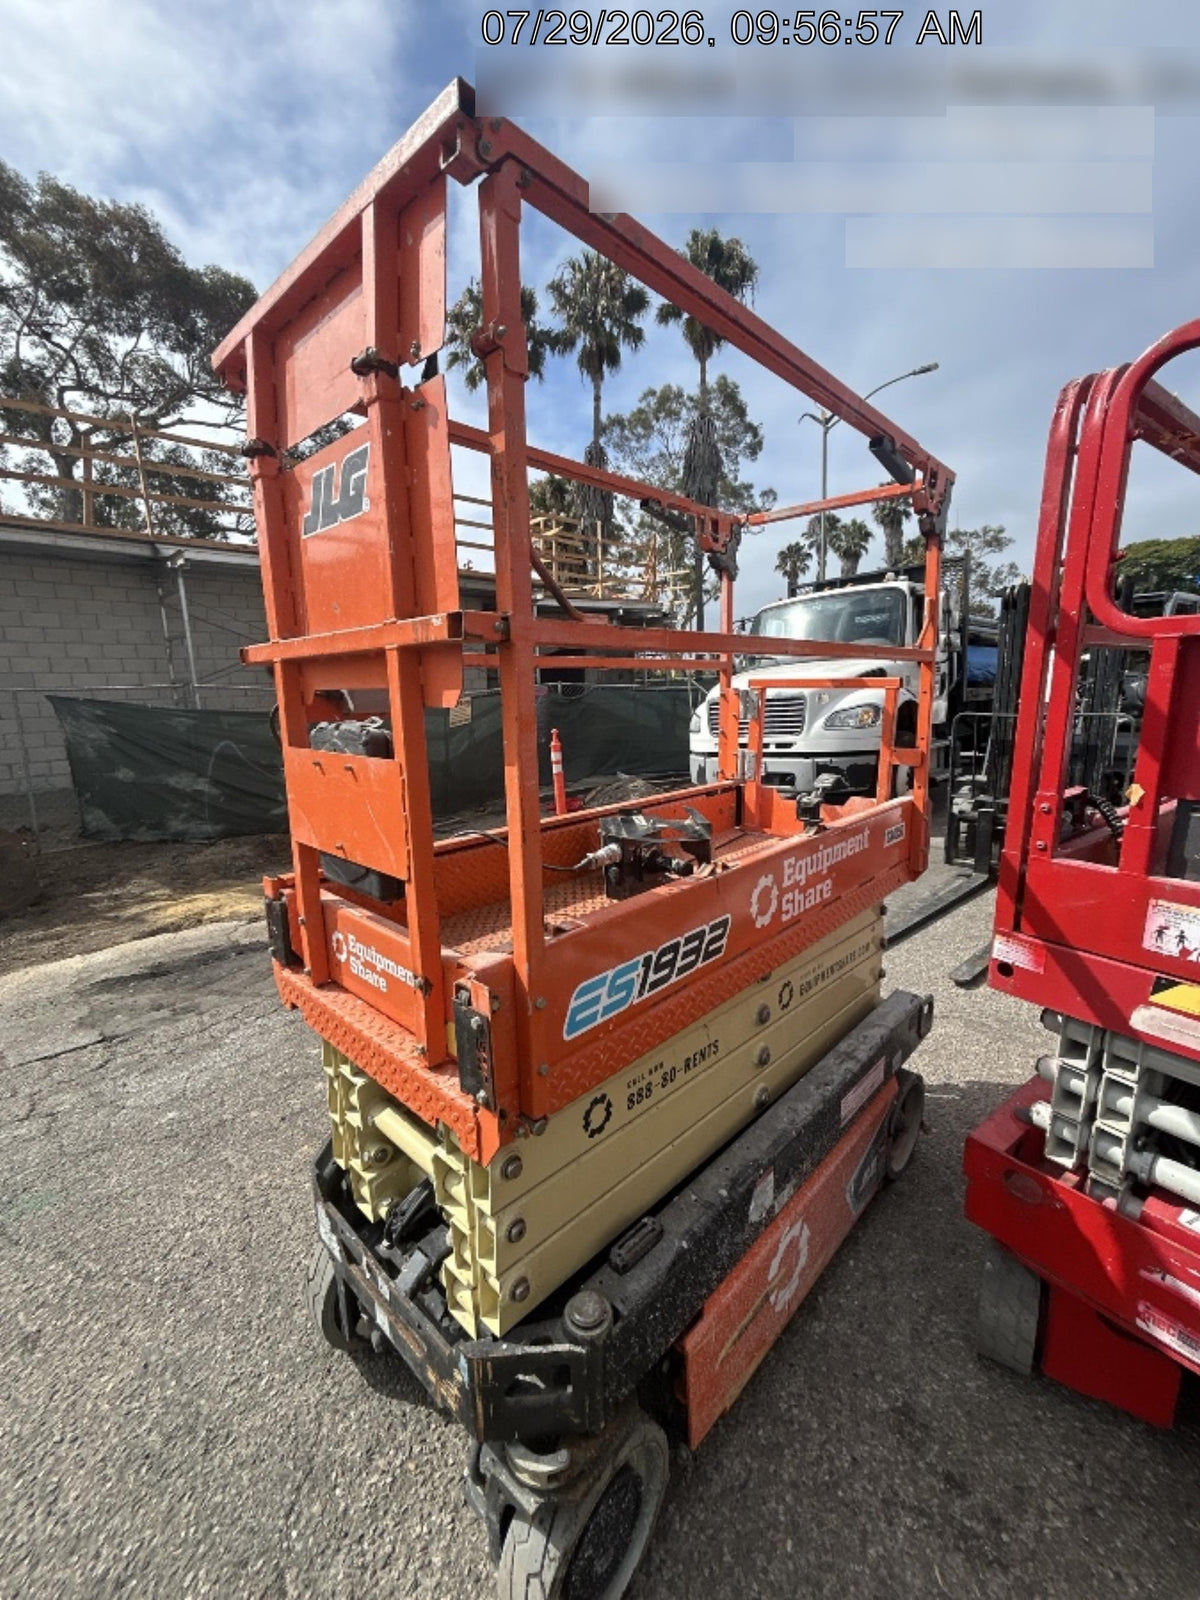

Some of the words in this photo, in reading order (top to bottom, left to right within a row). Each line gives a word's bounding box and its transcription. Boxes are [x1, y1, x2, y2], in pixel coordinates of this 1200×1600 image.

[302, 442, 369, 538] JLG
[782, 826, 870, 888] Equipment
[781, 878, 833, 922] Share
[350, 955, 387, 992] Share
[563, 913, 732, 1041] ES1932
[626, 1039, 720, 1111] 888-80-RENTS
